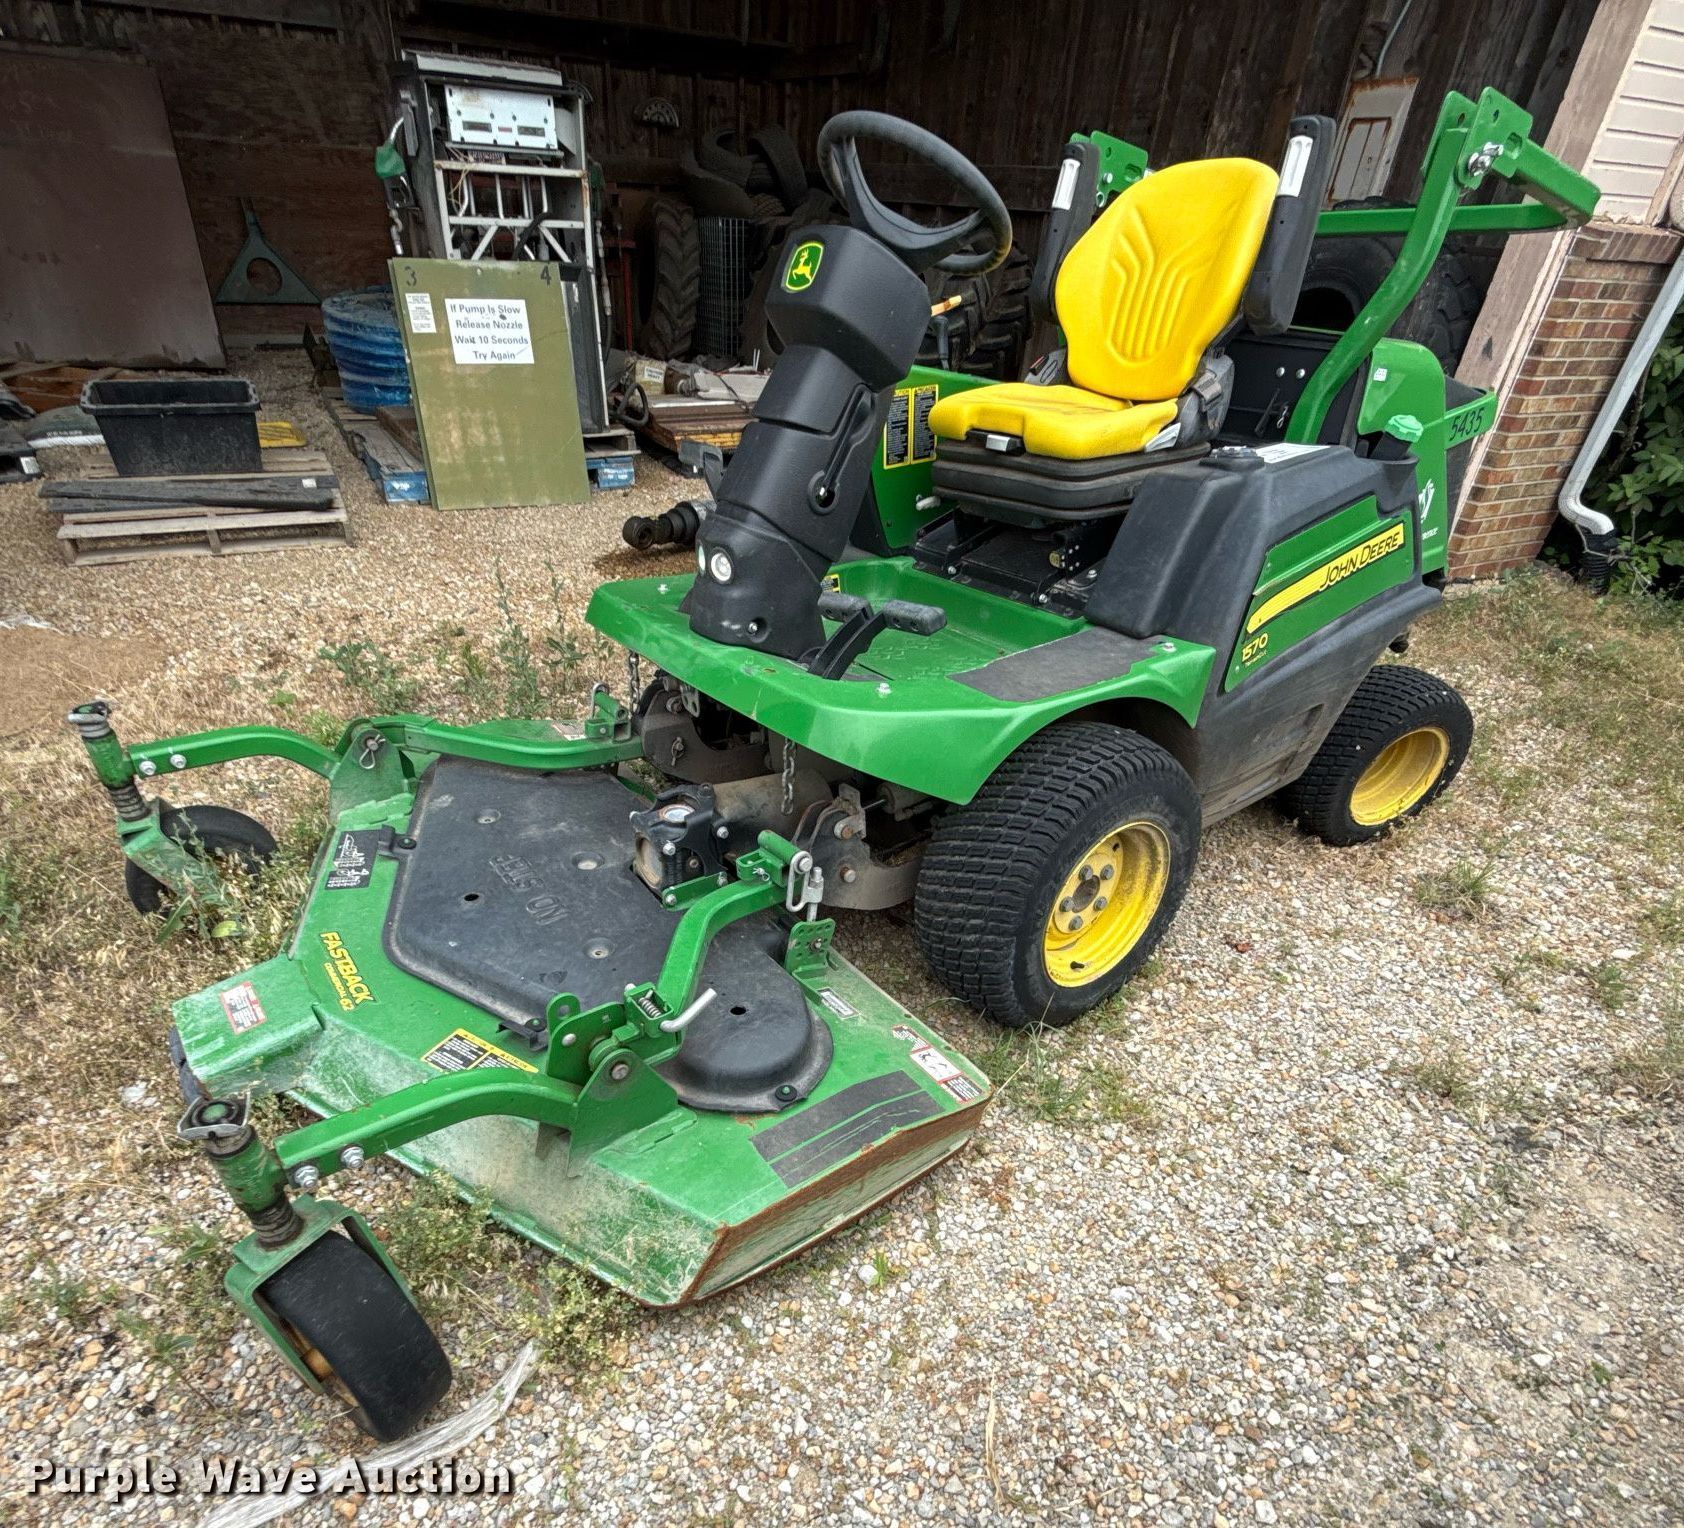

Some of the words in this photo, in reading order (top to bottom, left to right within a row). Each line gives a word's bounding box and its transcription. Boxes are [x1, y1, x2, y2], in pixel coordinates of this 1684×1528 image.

[404, 265, 417, 287] 3
[540, 264, 552, 286] 4
[450, 304, 457, 313] If
[459, 304, 486, 315] Pump
[487, 305, 496, 314] Is
[497, 305, 521, 314] Slow
[455, 319, 491, 329] Release
[492, 320, 523, 330] Nozzle
[454, 335, 476, 345] Wait
[479, 335, 489, 345] 10
[491, 335, 529, 345] Seconds
[472, 350, 488, 361] Try
[490, 350, 516, 361] Again
[1449, 407, 1486, 442] 5435
[1319, 553, 1358, 589] JOHN
[1359, 531, 1400, 566] DEERE
[1241, 632, 1269, 662] 1570
[319, 931, 375, 1005] FASTBACK
